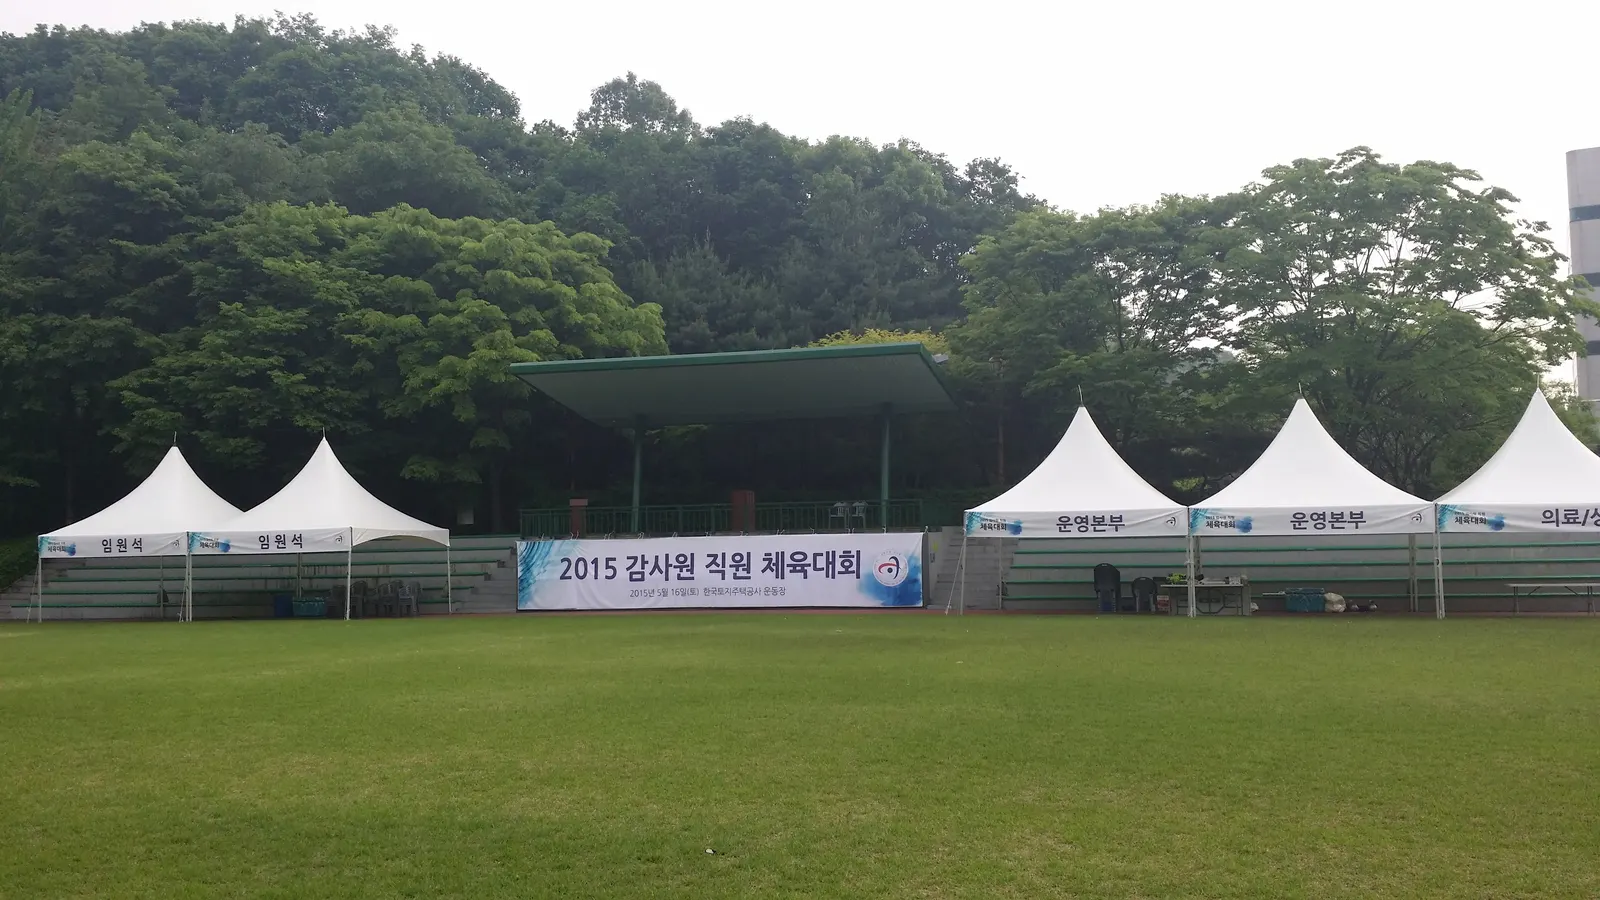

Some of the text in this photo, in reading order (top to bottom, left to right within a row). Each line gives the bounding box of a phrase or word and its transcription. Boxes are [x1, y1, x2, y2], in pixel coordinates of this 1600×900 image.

[979, 522, 1007, 531] 체육대회
[1056, 515, 1126, 533] 운영본부
[1205, 520, 1236, 529] 체육대회
[1290, 511, 1367, 530] 운영본부
[1454, 516, 1487, 525] 체육대회
[559, 557, 617, 580] 2015
[625, 552, 696, 582] 감사원
[705, 551, 752, 580] 직원
[760, 549, 861, 580] 체육대회
[629, 586, 786, 598] 2015년 5월 16일(토) 한국토지주택공사 운동장
